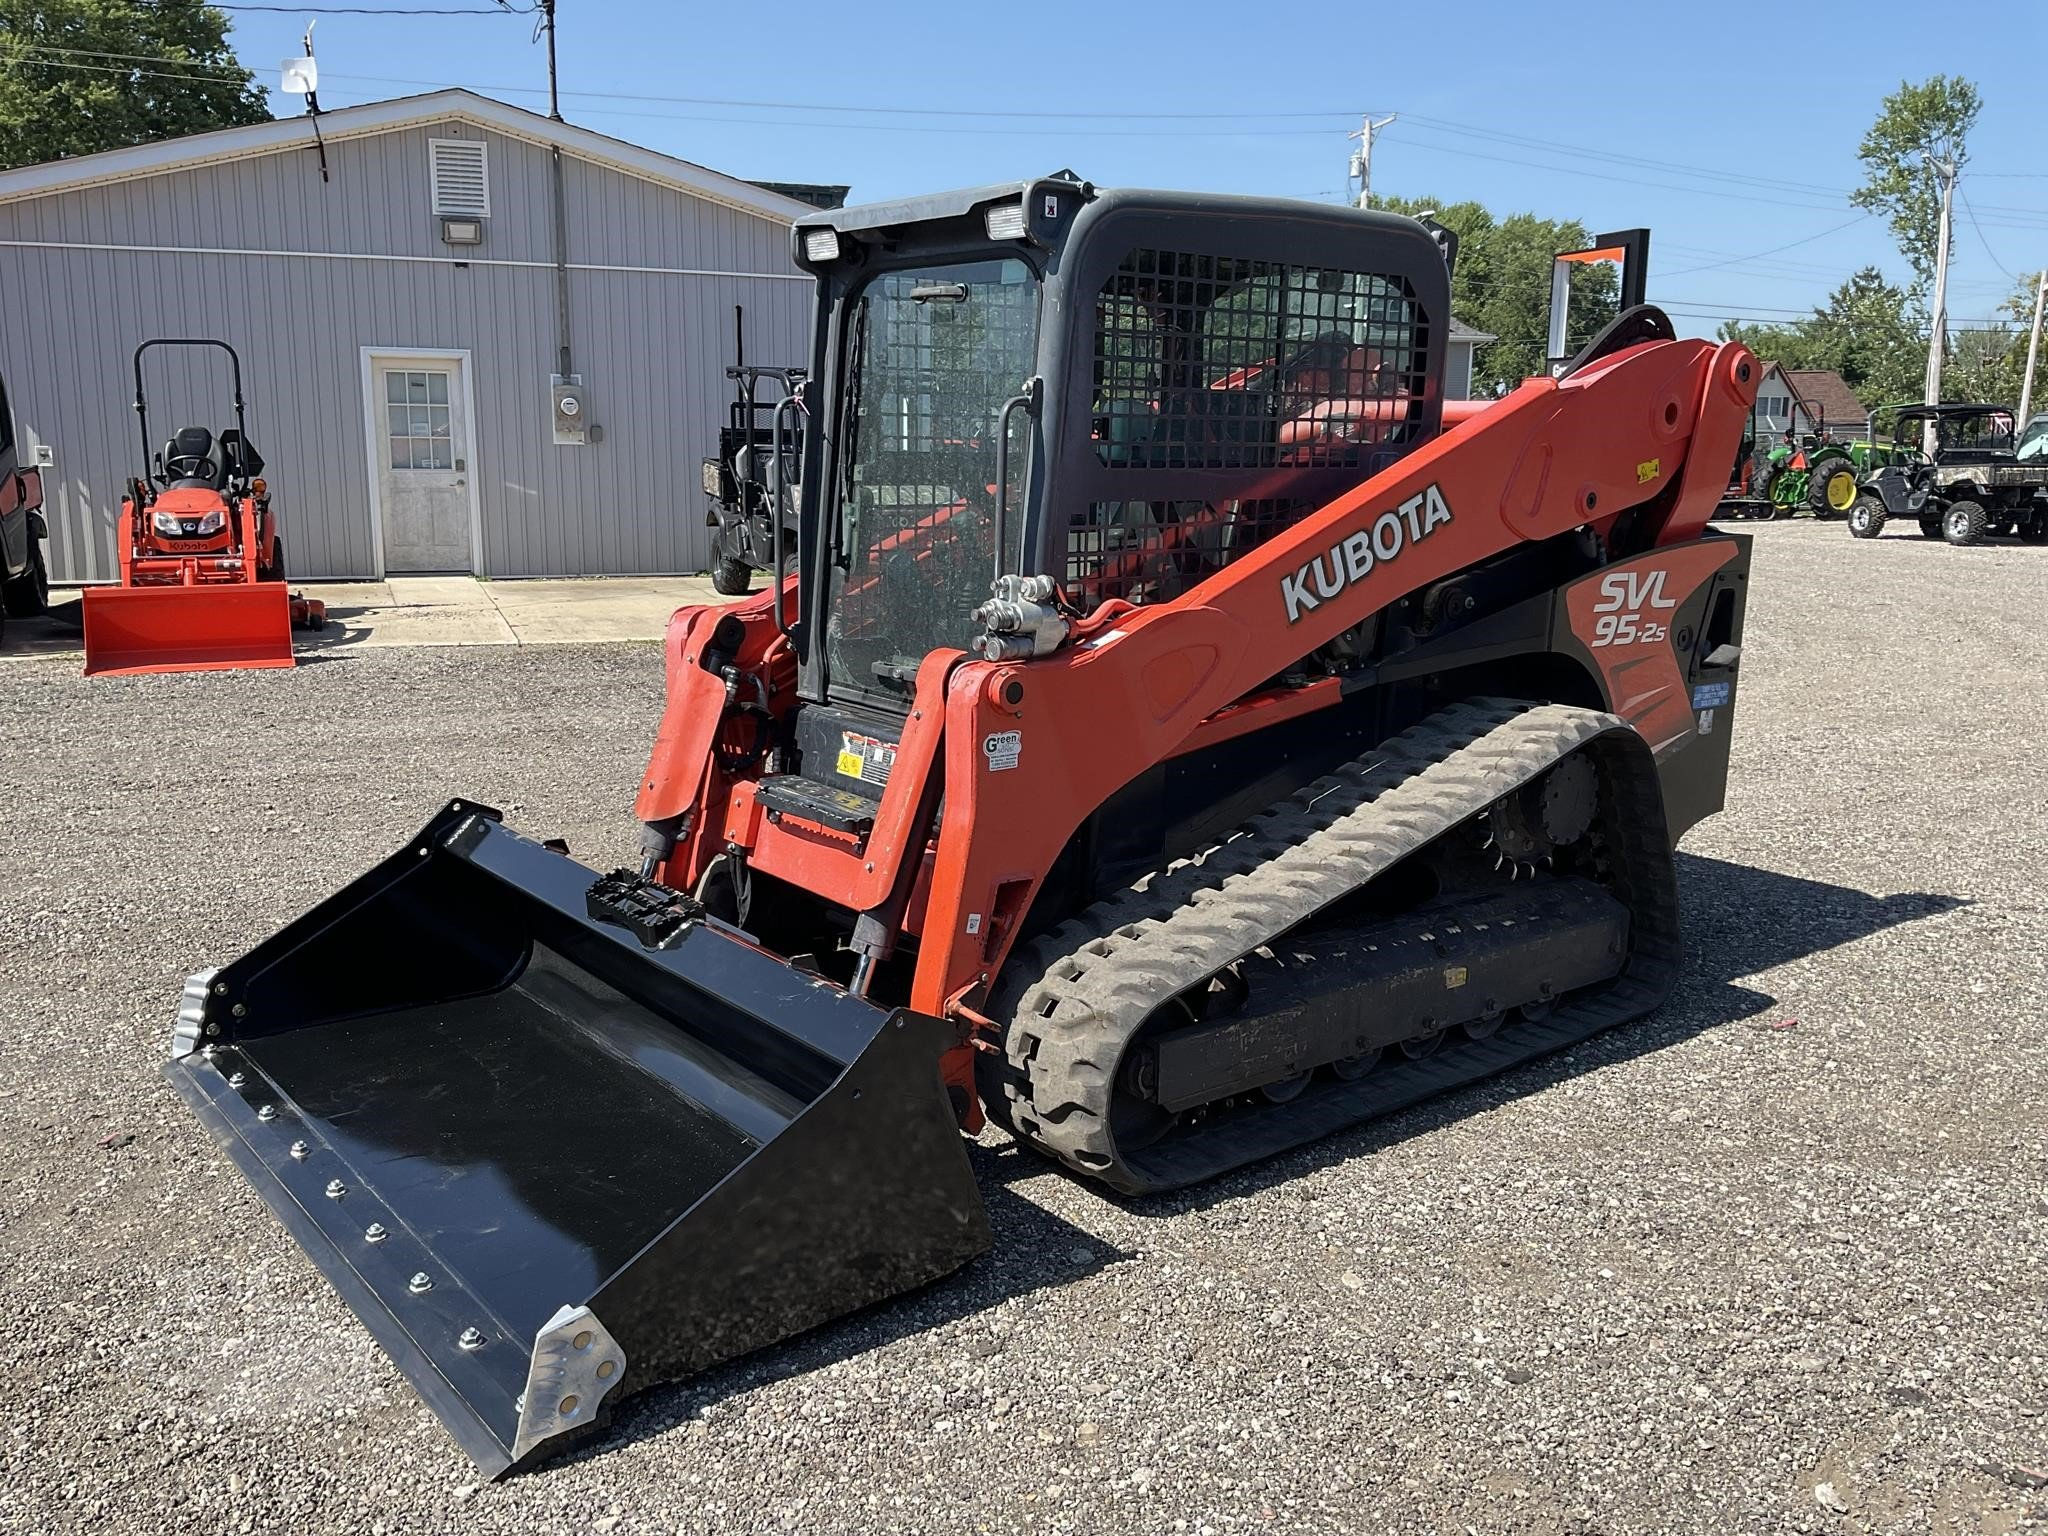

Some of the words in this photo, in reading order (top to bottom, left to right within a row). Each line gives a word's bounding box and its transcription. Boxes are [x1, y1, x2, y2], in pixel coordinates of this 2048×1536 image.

[169, 542, 208, 551] Kubota
[1281, 484, 1452, 622] KUBOTA
[1593, 571, 1676, 613] SVL
[986, 735, 1017, 753] Green
